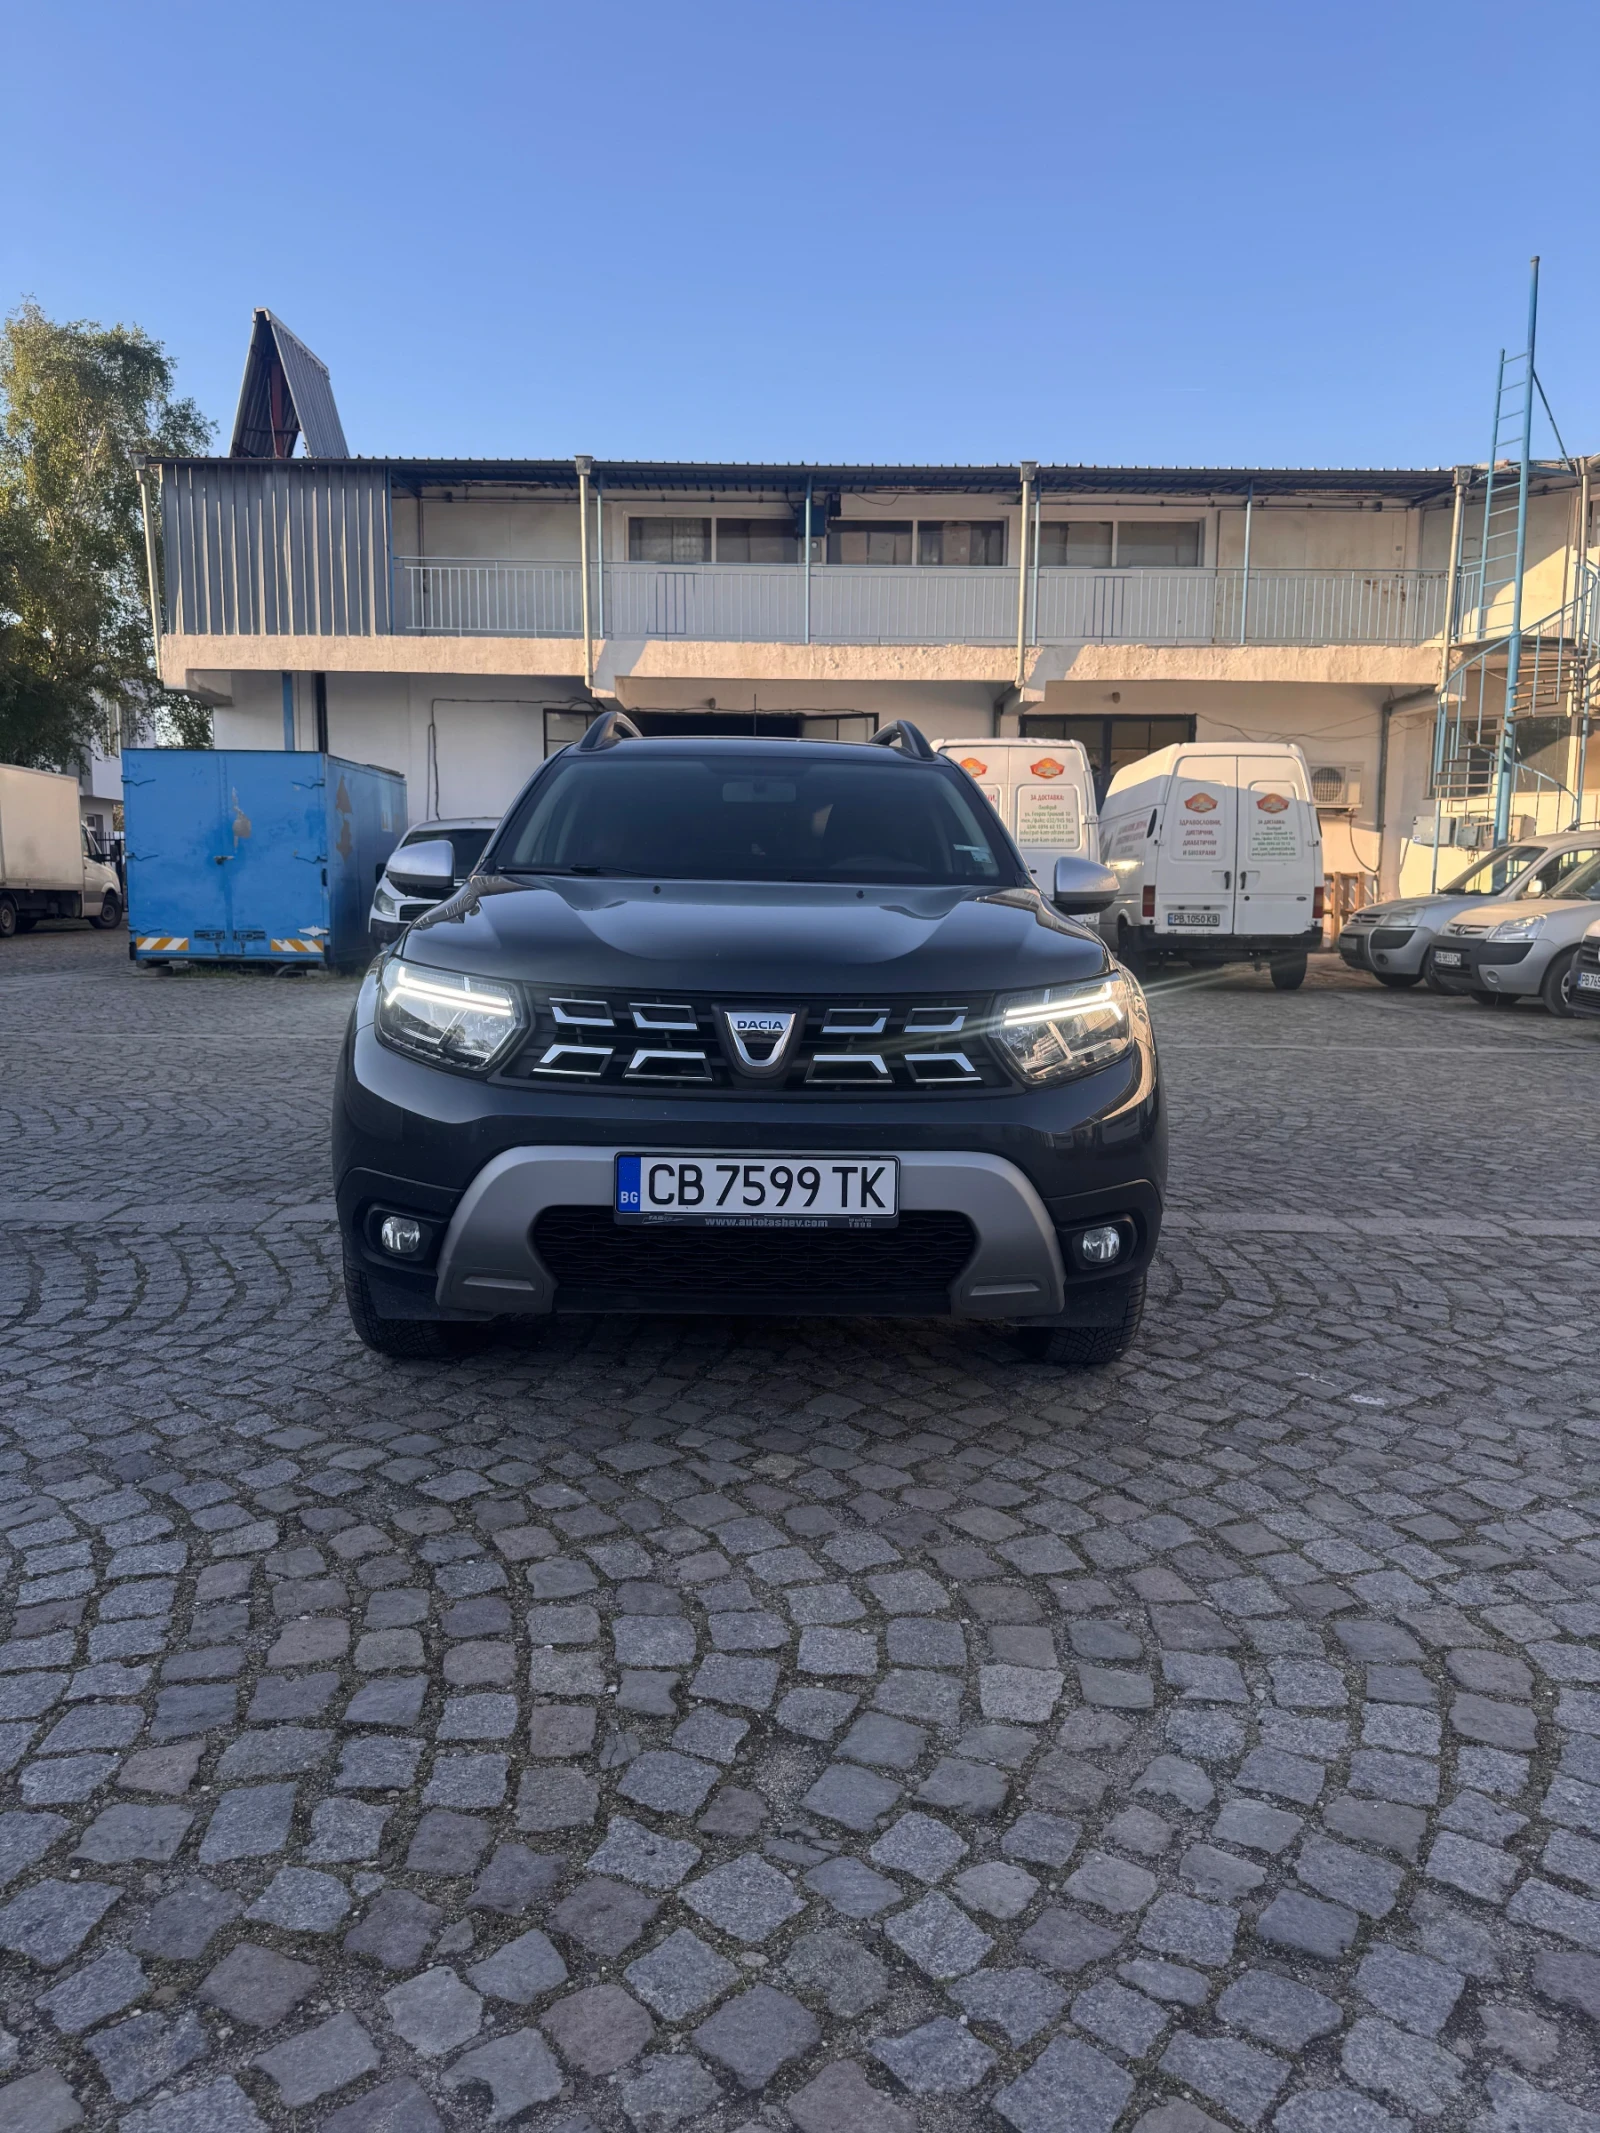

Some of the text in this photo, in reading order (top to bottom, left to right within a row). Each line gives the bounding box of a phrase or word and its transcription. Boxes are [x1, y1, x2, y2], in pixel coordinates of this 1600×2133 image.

[1174, 914, 1218, 924] PB 1050 KB
[1582, 974, 1589, 986] PB
[737, 1020, 784, 1029] DACIA
[648, 1163, 886, 1208] CB 7599 TK
[620, 1191, 639, 1203] BG
[705, 1217, 829, 1228] www.autotashev.com
